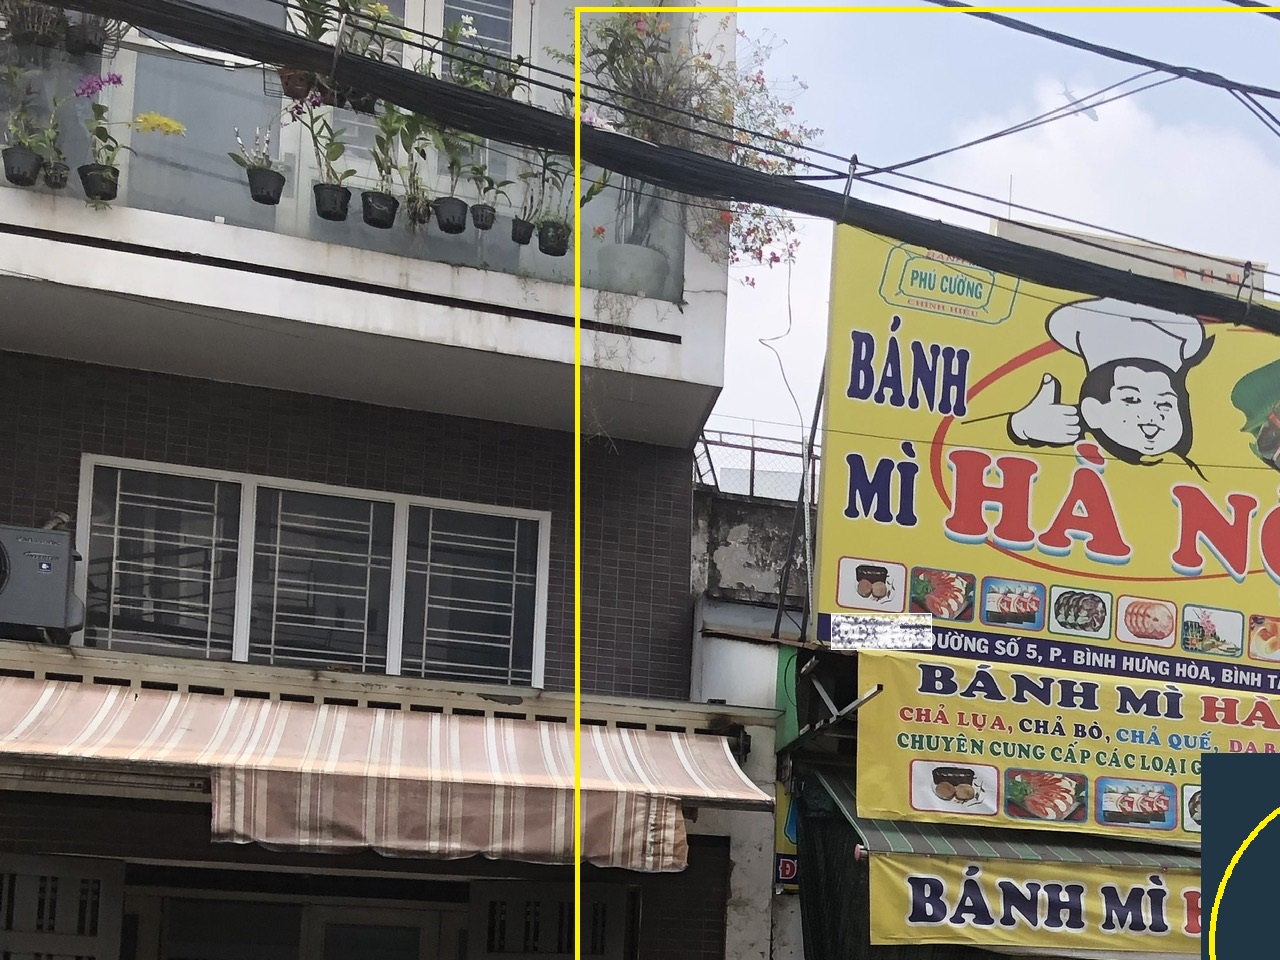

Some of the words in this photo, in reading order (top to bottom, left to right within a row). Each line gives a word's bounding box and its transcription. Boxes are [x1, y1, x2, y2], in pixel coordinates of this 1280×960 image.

[910, 268, 936, 290] PHÚ
[940, 274, 983, 300] CƯỜNG
[846, 315, 970, 417] BÁNH
[842, 441, 920, 528] MÌ
[943, 438, 1132, 565] HÀ
[994, 636, 1022, 658] SỐ
[1026, 643, 1043, 663] 5,
[1049, 647, 1067, 663] P.
[1072, 649, 1116, 669] BÌNH
[1121, 655, 1170, 676] HƯNG
[1175, 661, 1216, 684] HÒA,
[1221, 666, 1262, 688] BÌNH
[917, 663, 1100, 711] BÁNH
[1115, 683, 1185, 720] MÌ
[896, 732, 985, 755] CHUYÊN
[989, 741, 1046, 761] CUNG
[1050, 740, 1091, 764] CẤP
[1095, 748, 1136, 769] CÁC
[1140, 756, 1186, 776] LOẠI
[899, 703, 950, 725] CHẢ
[957, 711, 1014, 734] LỤA,
[1018, 715, 1067, 737] CHẢ
[1073, 721, 1111, 743] BÒ,
[1115, 725, 1162, 746] CHẢ
[1167, 728, 1220, 754] QUẾ,
[908, 865, 1086, 930] BÁNH
[1101, 874, 1169, 933] MÌ
